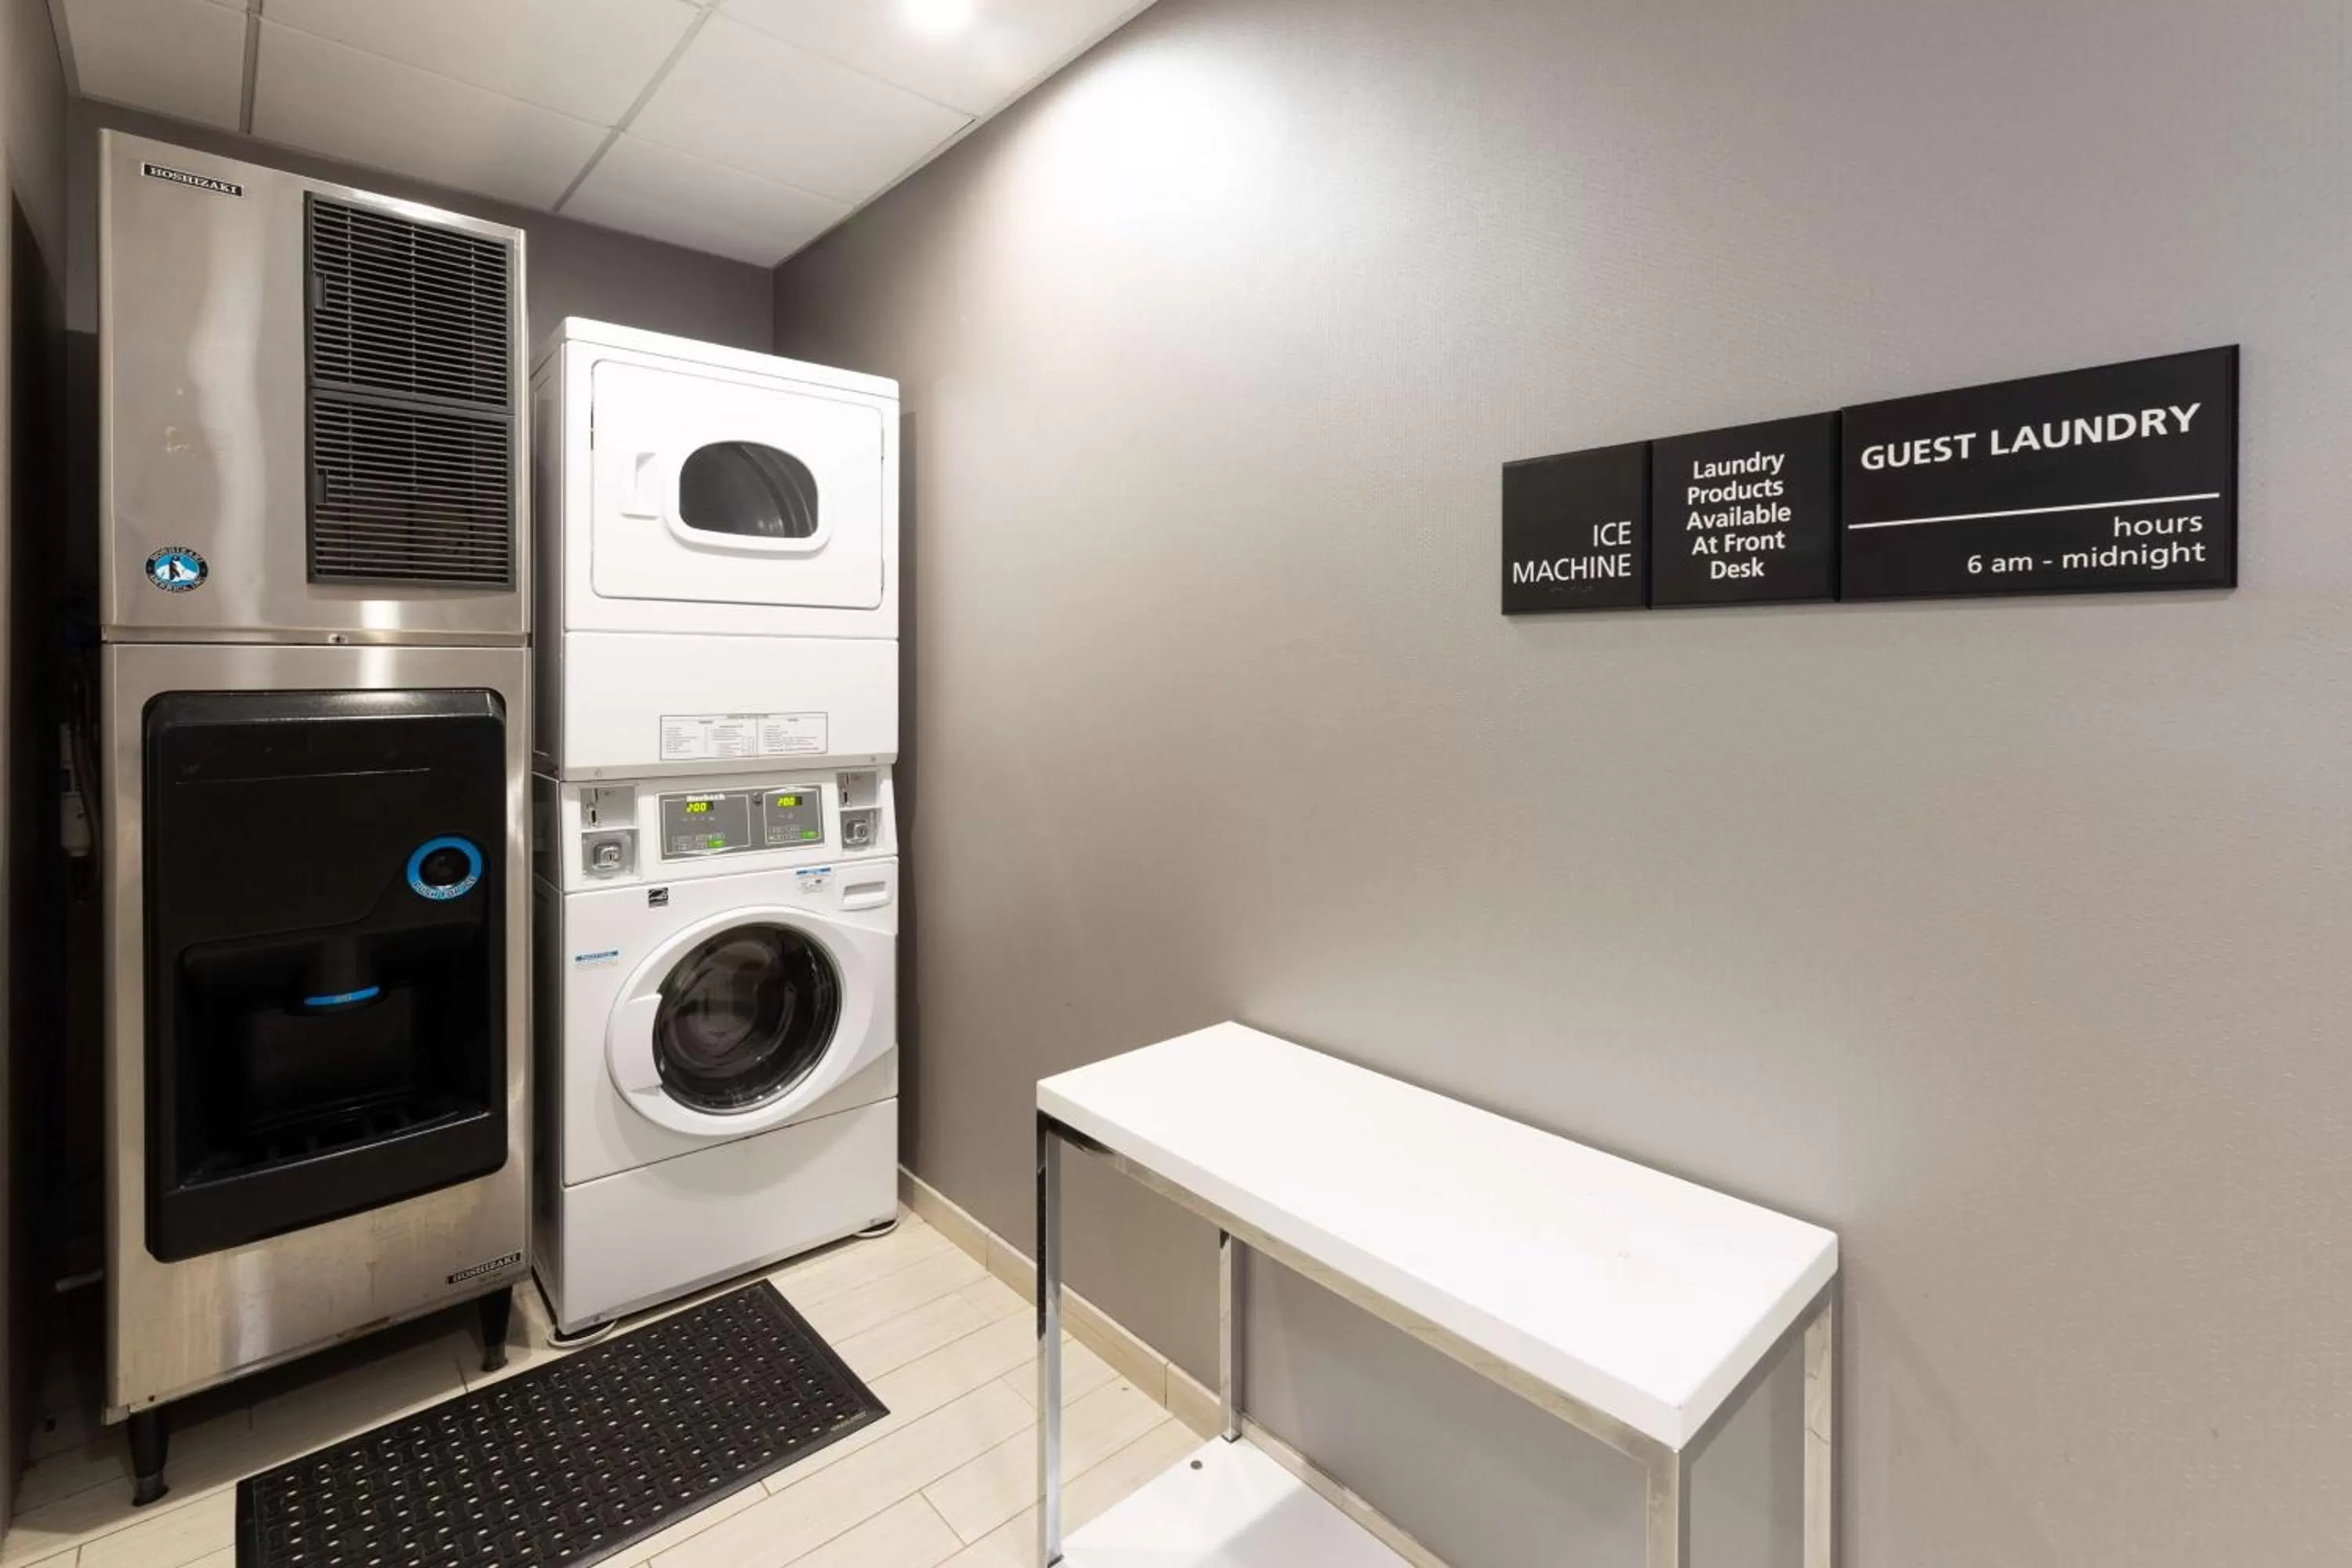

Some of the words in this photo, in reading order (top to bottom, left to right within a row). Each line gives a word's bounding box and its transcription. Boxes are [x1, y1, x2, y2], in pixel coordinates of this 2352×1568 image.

[150, 166, 236, 194] HOSHIZAKI
[1860, 432, 1976, 470] GUEST
[1991, 402, 2201, 456] LAUNDRY
[1693, 451, 1785, 480] Laundry
[1687, 478, 1784, 506] Products
[1686, 501, 1791, 531] Available
[2114, 515, 2203, 537] hours
[1593, 521, 1632, 547] ICE
[1691, 535, 1719, 556] At
[1724, 530, 1786, 553] Front
[1512, 553, 1632, 584] MACHINE
[1710, 556, 1765, 579] Desk
[1967, 554, 1983, 574] 6
[1991, 556, 2033, 573] am
[2063, 541, 2206, 570] midnight
